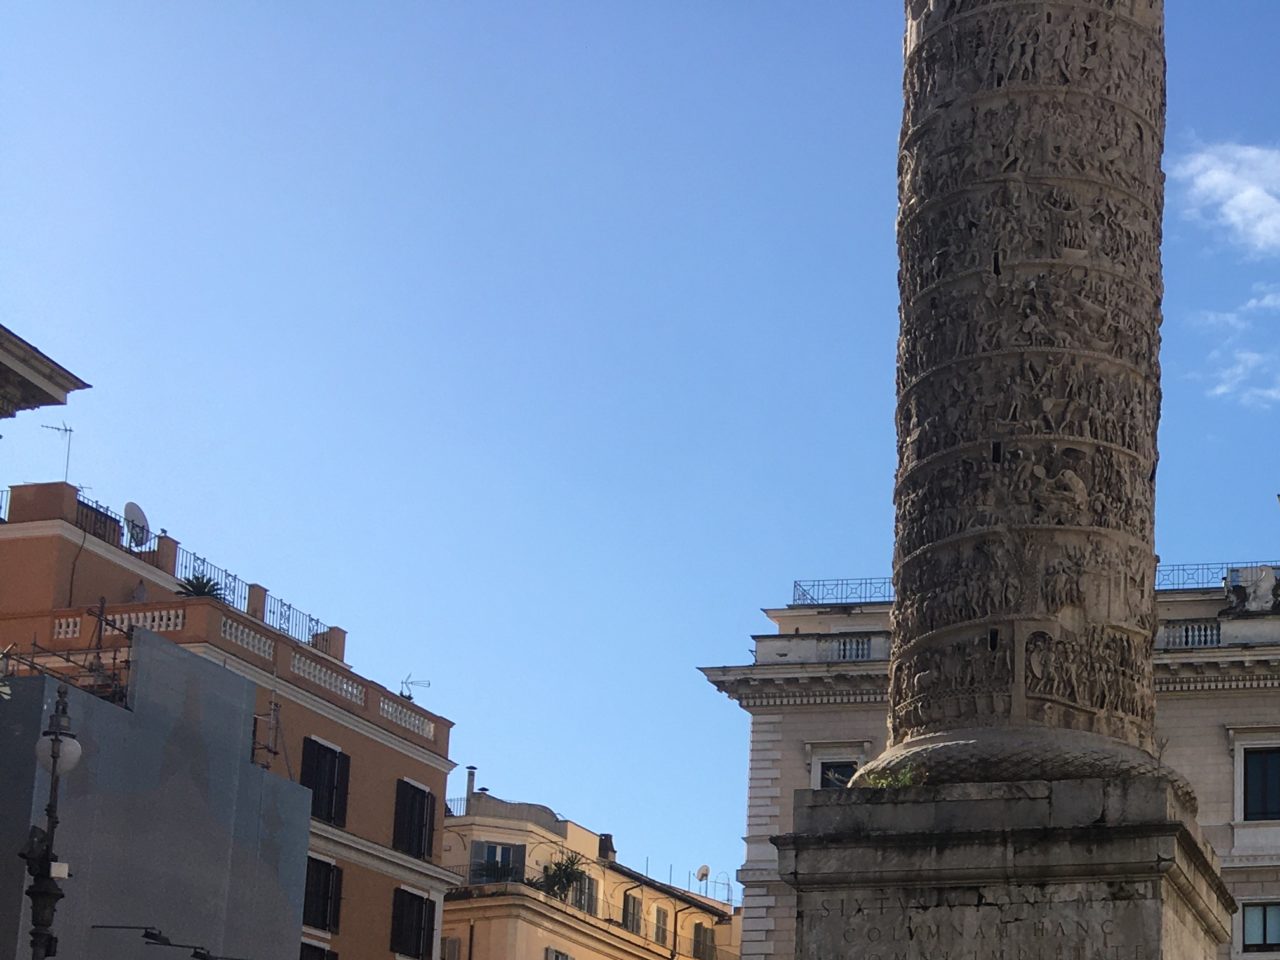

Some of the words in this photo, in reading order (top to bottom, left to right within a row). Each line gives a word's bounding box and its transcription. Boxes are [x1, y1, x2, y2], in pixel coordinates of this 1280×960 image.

[820, 896, 928, 918] SIXTVS
[843, 923, 1009, 943] COLVMNAM
[1033, 920, 1113, 938] HANC
